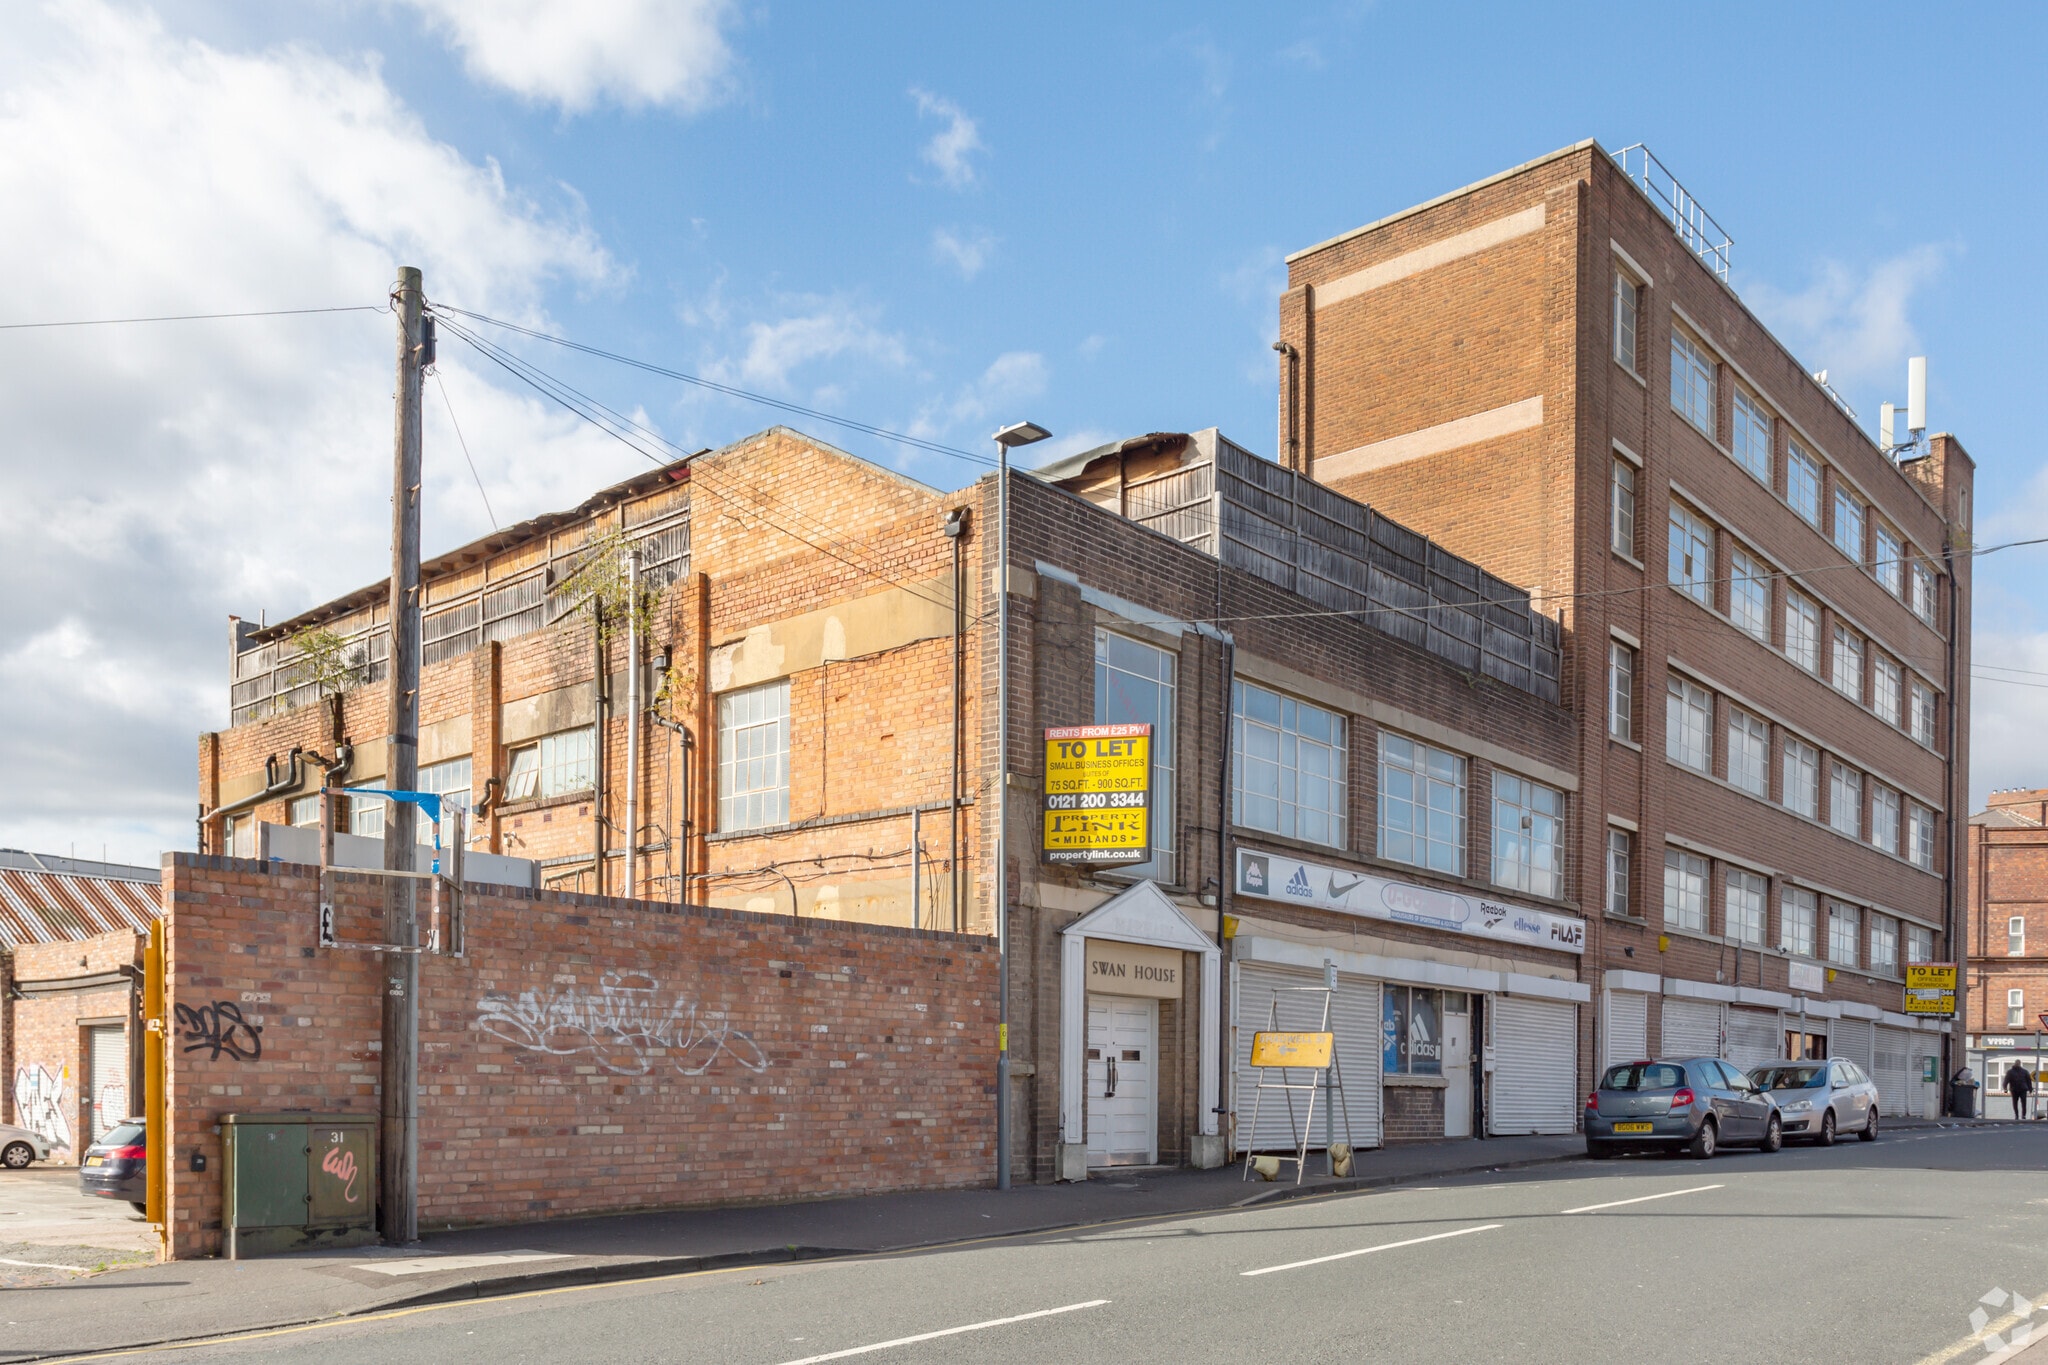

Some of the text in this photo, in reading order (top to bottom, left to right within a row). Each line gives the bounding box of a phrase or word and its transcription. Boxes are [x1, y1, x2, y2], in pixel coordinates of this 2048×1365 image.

[1049, 725, 1145, 738] RENTS FROM £25 PW
[1057, 739, 1137, 759] TO LET
[1049, 759, 1145, 770] SMALL BUSINESS OFFICES
[1050, 781, 1060, 791] 75
[1062, 780, 1090, 790] SQ.FT.
[1097, 779, 1113, 789] 900
[1114, 777, 1143, 788] SQ.FT.
[1048, 792, 1145, 809] 0121 200 3344
[1062, 813, 1140, 821] PROPERTY
[1063, 835, 1127, 844] MIDLANDS
[1049, 849, 1141, 860] propertylink.co.uk
[1285, 884, 1313, 898] adidas
[1481, 902, 1507, 917] Reebok
[1513, 917, 1541, 934] ellesse
[1551, 922, 1574, 944] FILA
[1092, 961, 1176, 983] SWAN HOUSE
[1910, 967, 1953, 976] TO LET
[1987, 1037, 2015, 1046] YMCA
[331, 1131, 344, 1143] 31
